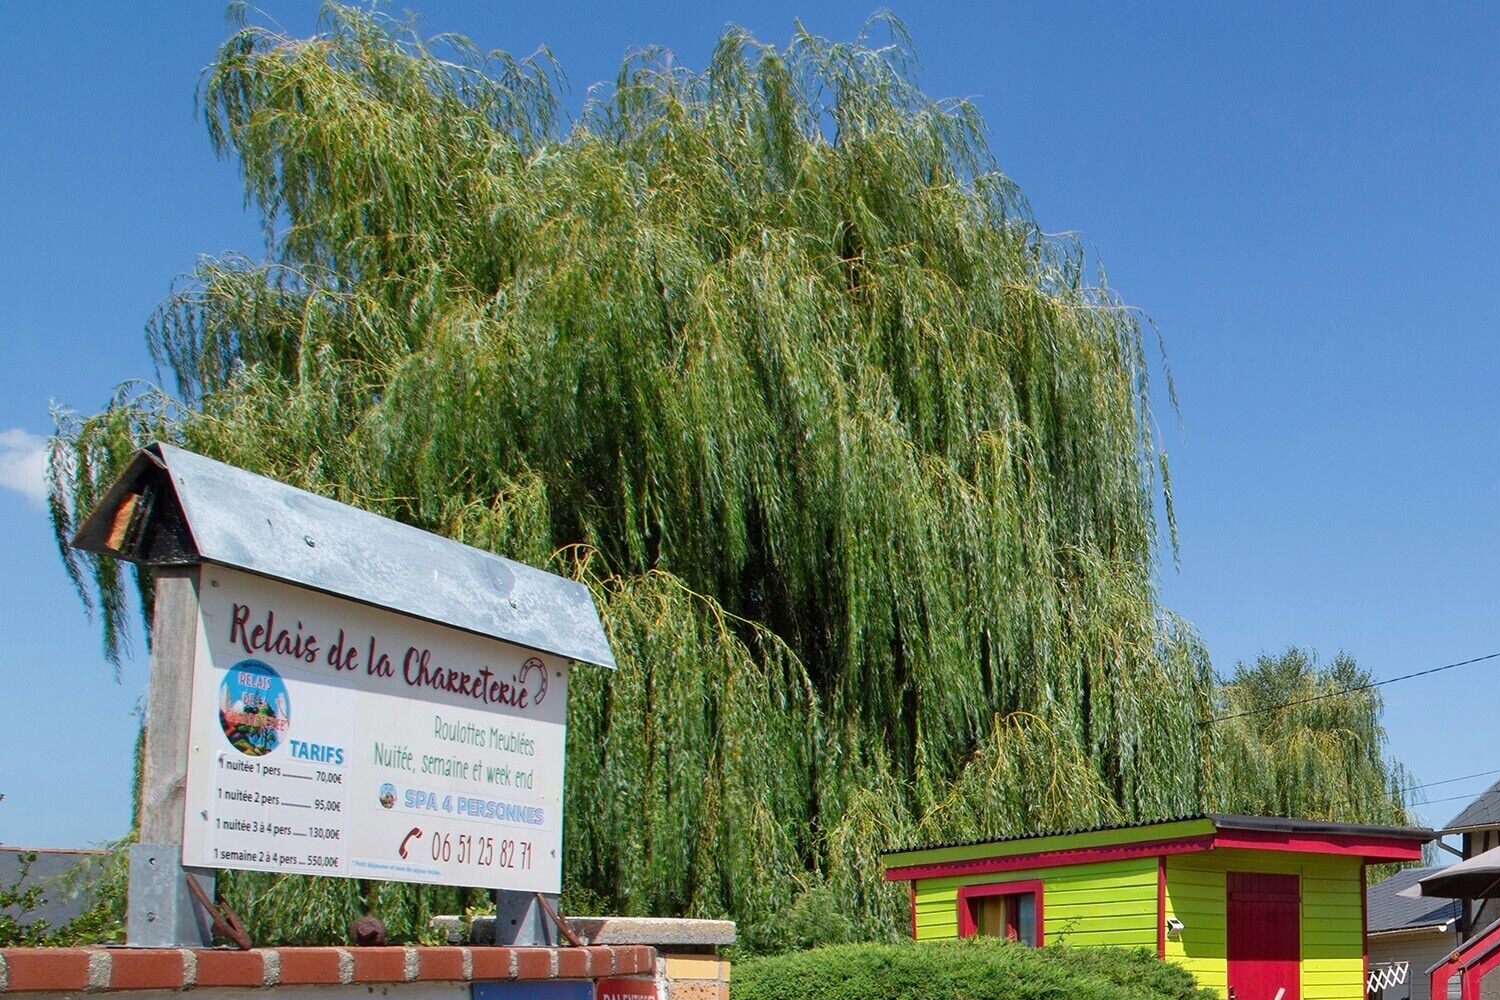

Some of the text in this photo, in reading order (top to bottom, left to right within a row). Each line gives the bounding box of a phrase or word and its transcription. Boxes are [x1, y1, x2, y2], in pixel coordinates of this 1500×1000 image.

[230, 602, 528, 709] Relais de la Charreterie
[434, 715, 535, 757] Roulottes Meublées
[290, 740, 345, 765] TARIFS
[374, 742, 534, 790] Nuitée, semaine et week end
[226, 760, 254, 773] nuitée
[256, 763, 260, 773] 1
[263, 766, 281, 777] pers
[316, 771, 342, 784] 70,00€
[218, 788, 341, 812] 1 nuitée 2 pers 95,00€
[404, 788, 544, 825] SPA 4 PERSONNES
[216, 818, 340, 840] 1 nuitée 3 à 4 pers 130,00€
[214, 848, 339, 867] 1 semaine 2 à 4 pers 550,00€
[431, 831, 532, 870] 06 51 25 82 71
